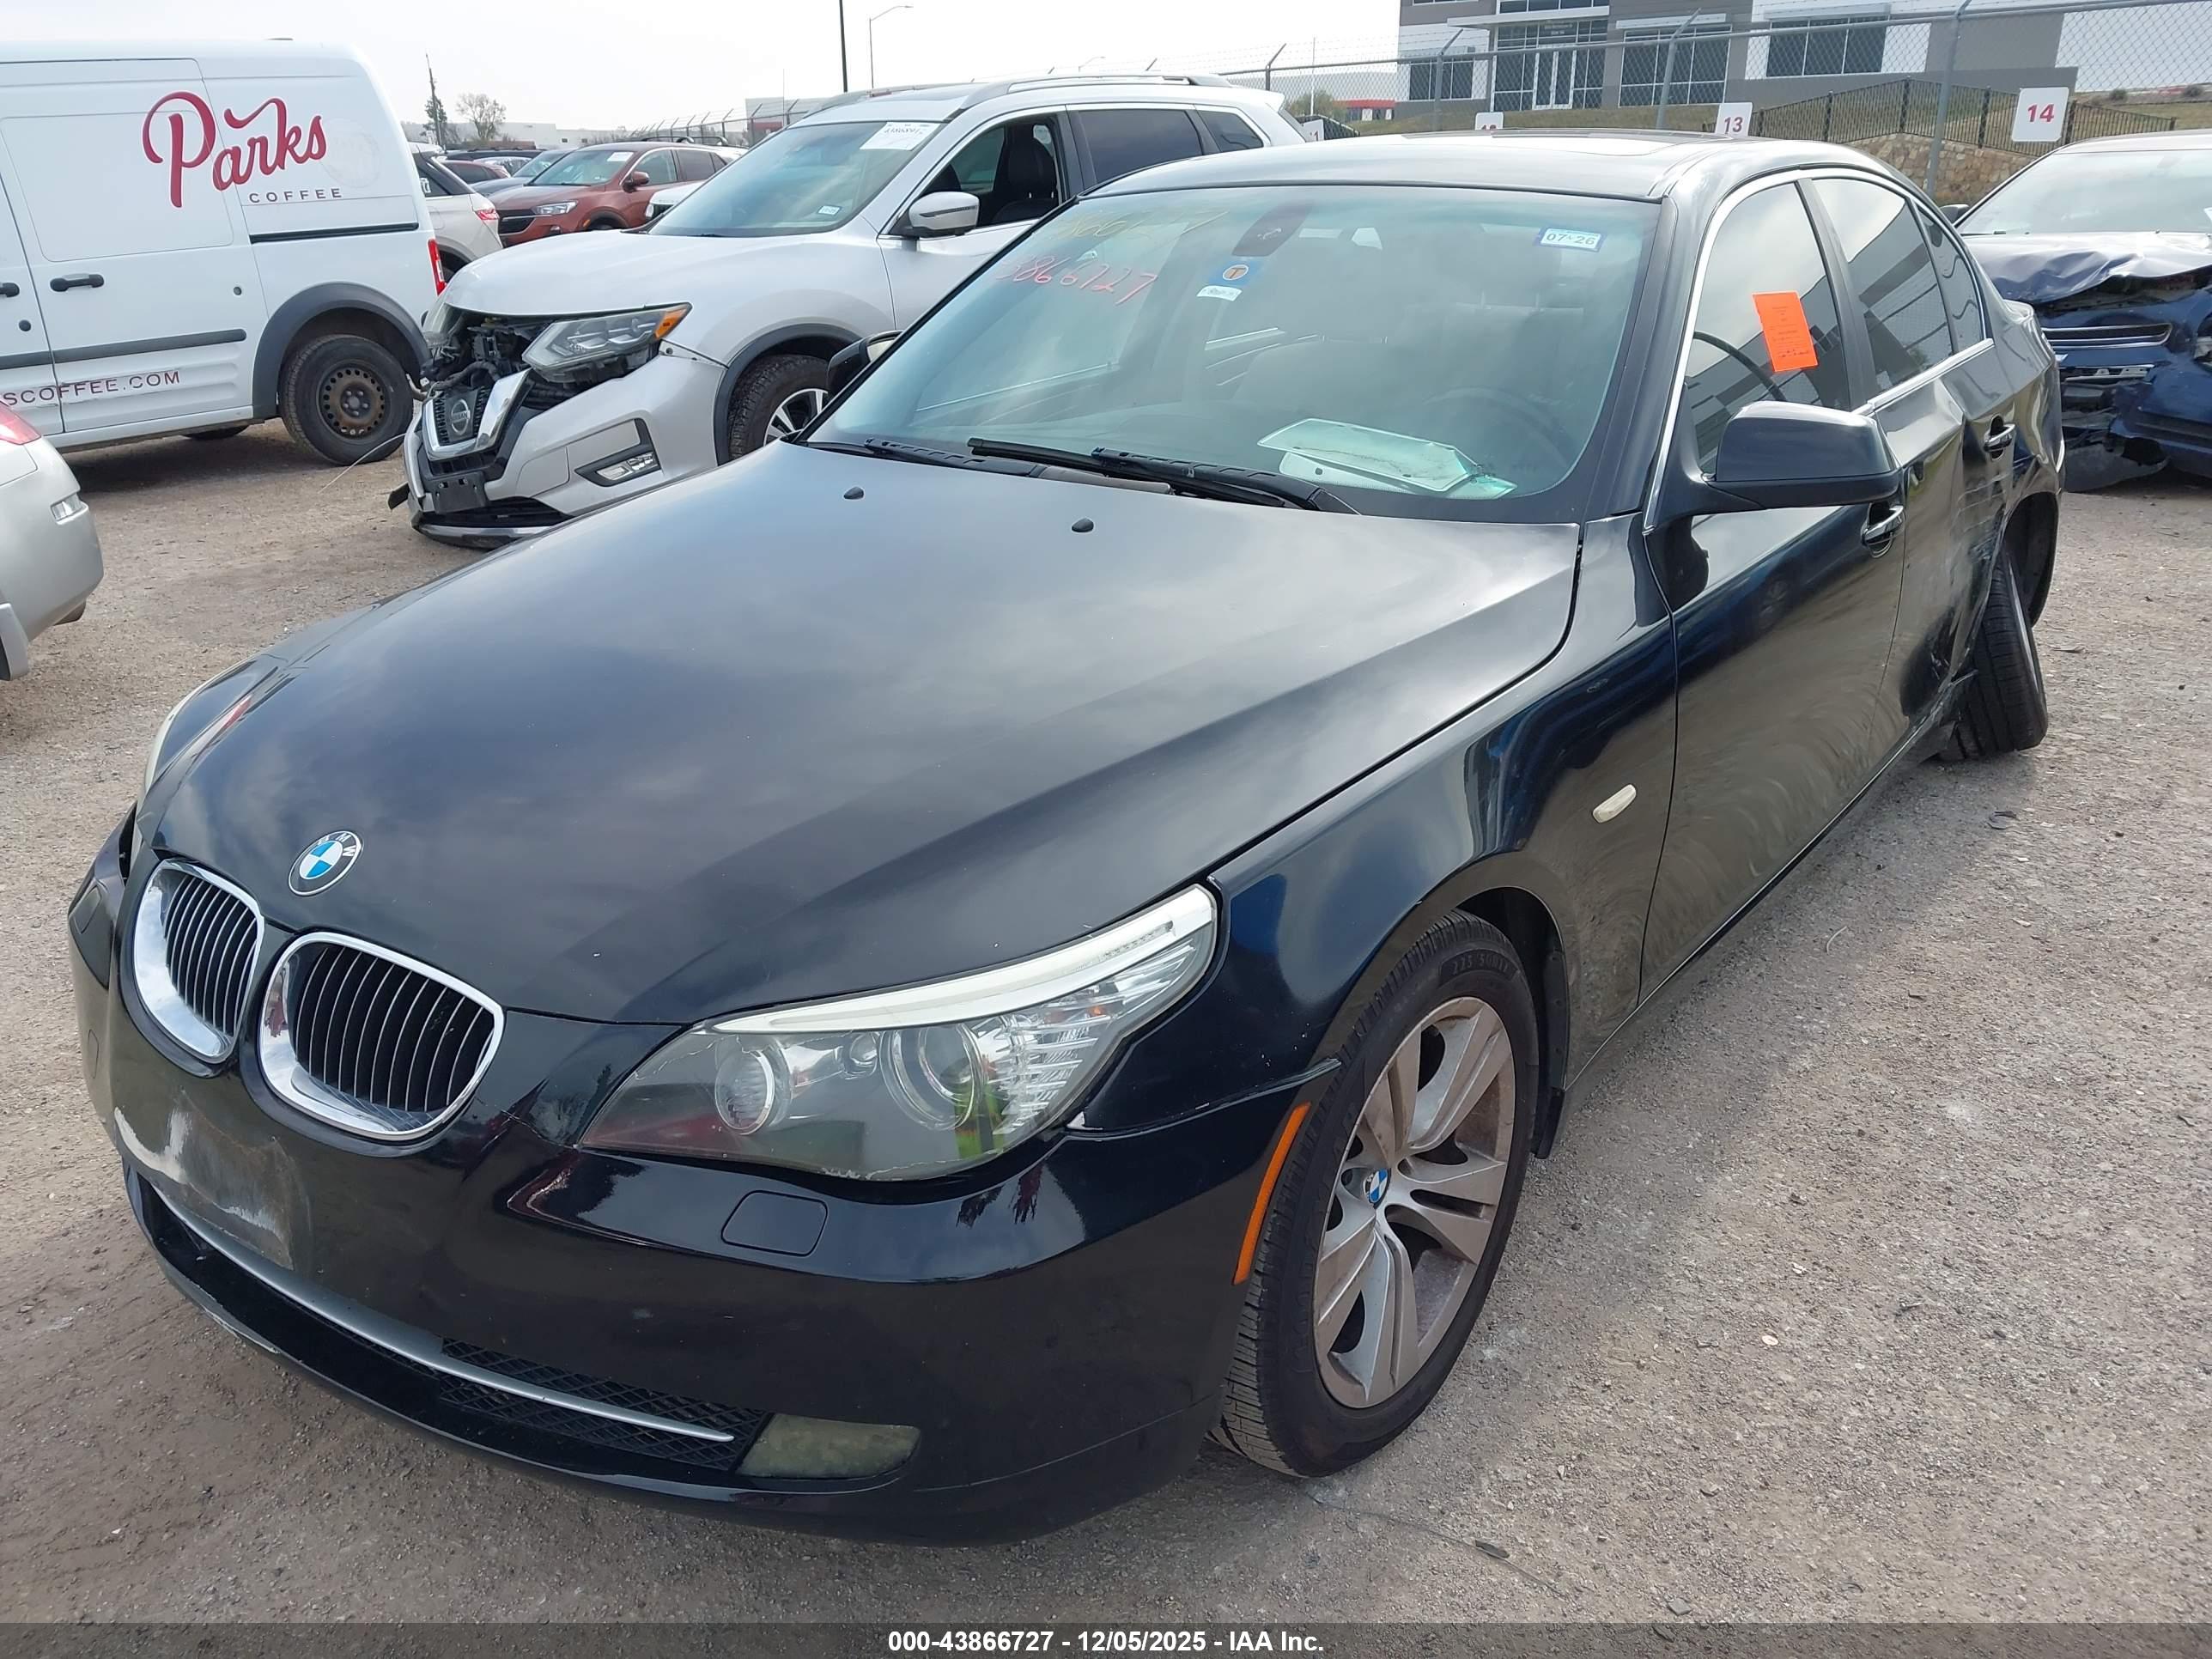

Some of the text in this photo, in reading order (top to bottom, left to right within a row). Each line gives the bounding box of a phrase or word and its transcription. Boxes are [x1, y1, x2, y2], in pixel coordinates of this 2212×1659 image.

[2027, 103, 2055, 123] 14
[1723, 116, 1744, 135] 13
[143, 91, 327, 208] Parks
[248, 187, 343, 204] COFFEE
